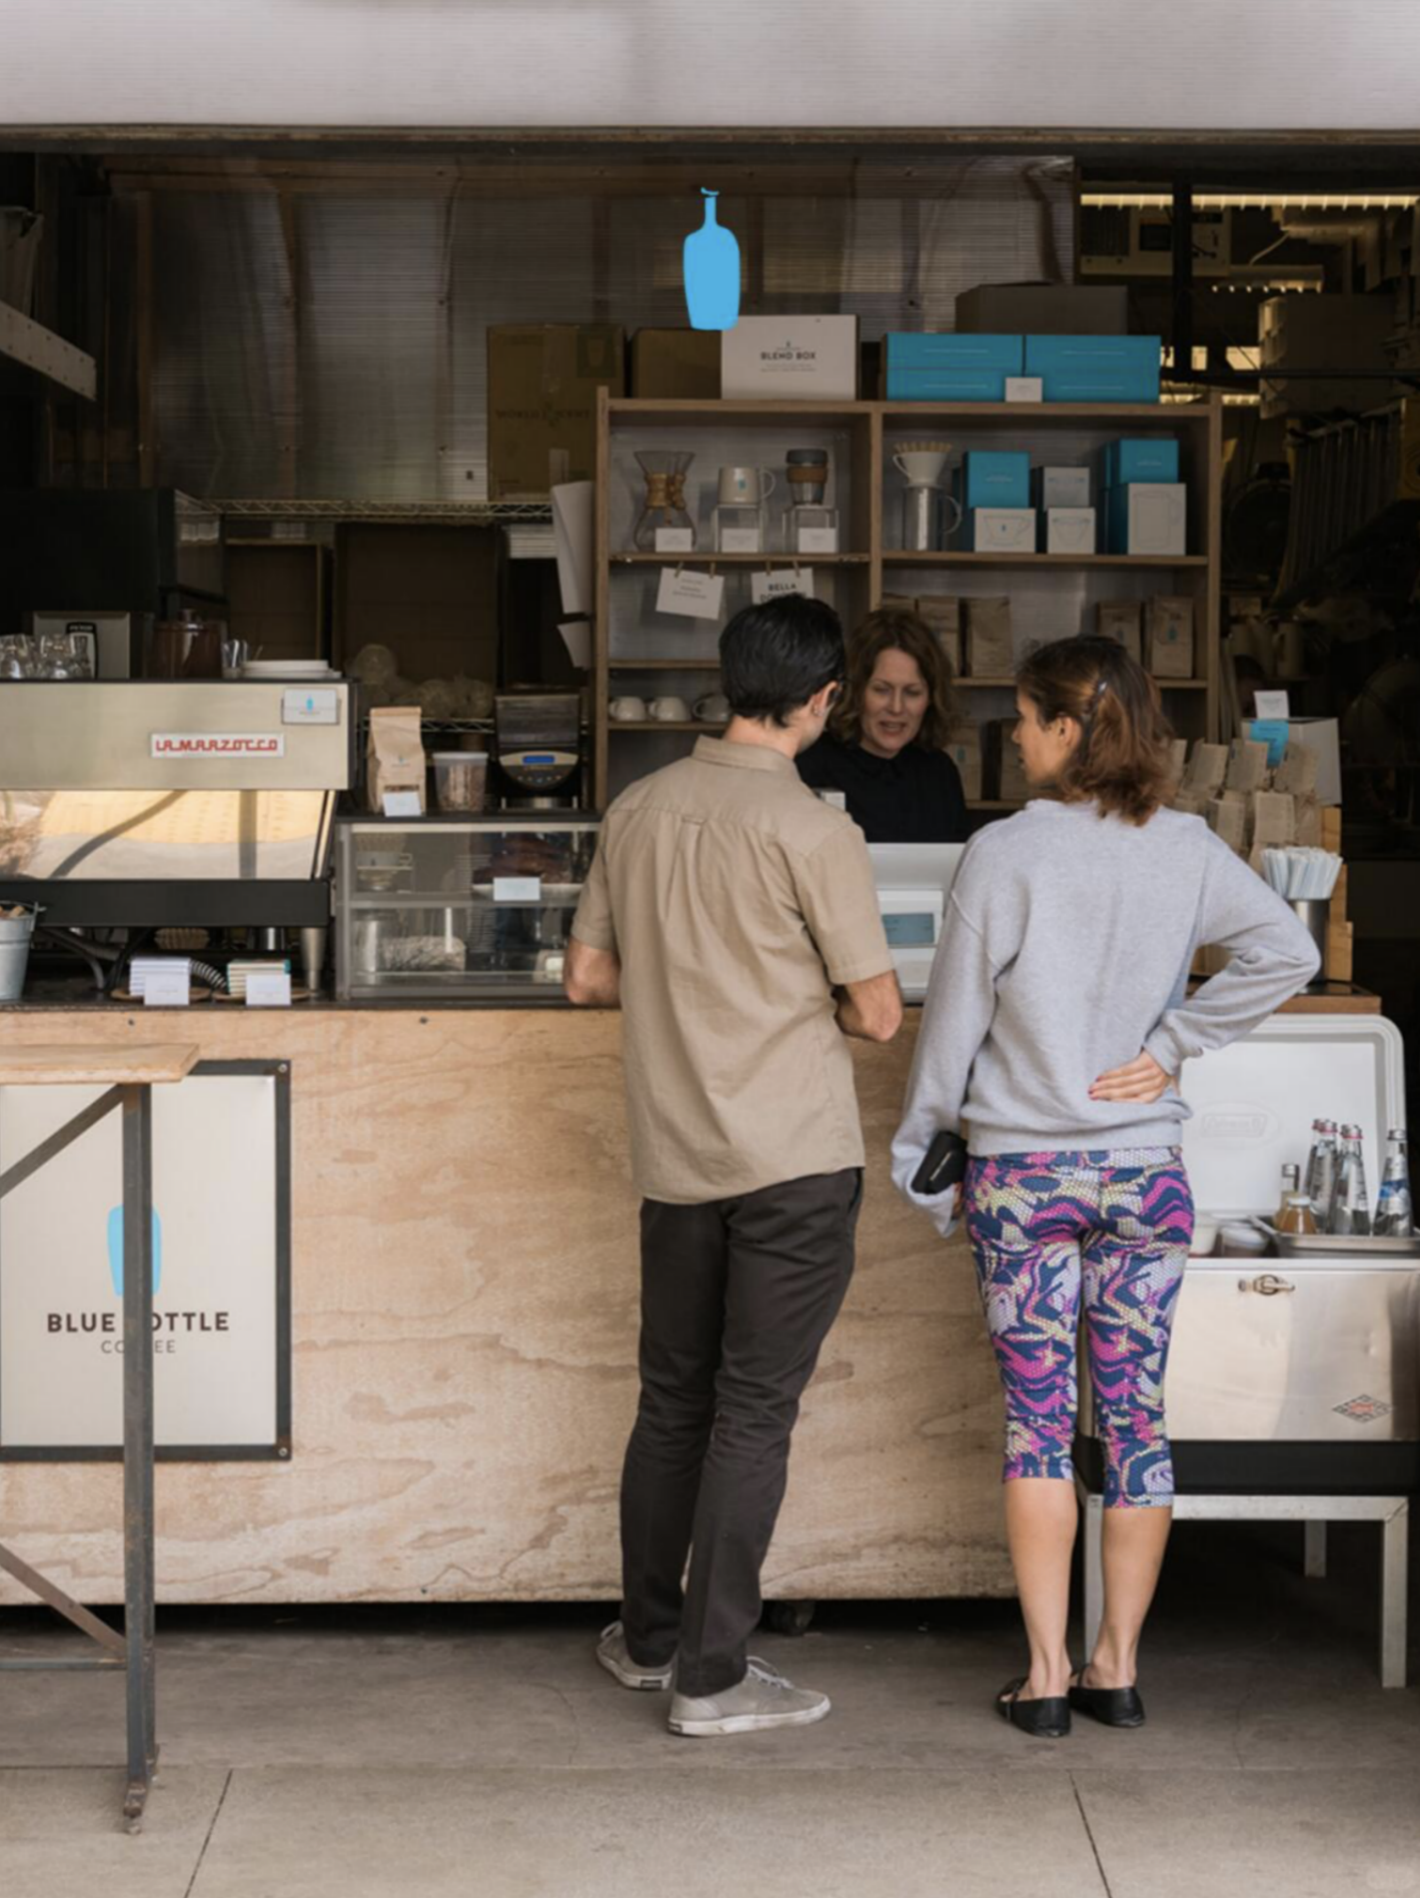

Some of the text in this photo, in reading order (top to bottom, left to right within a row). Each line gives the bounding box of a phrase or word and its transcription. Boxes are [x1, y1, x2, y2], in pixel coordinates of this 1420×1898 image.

[760, 352, 817, 360] BLEND BOX
[768, 583, 796, 591] BELLA
[47, 1311, 229, 1333] BLUE OTTLE
[100, 1339, 176, 1354] COEE
